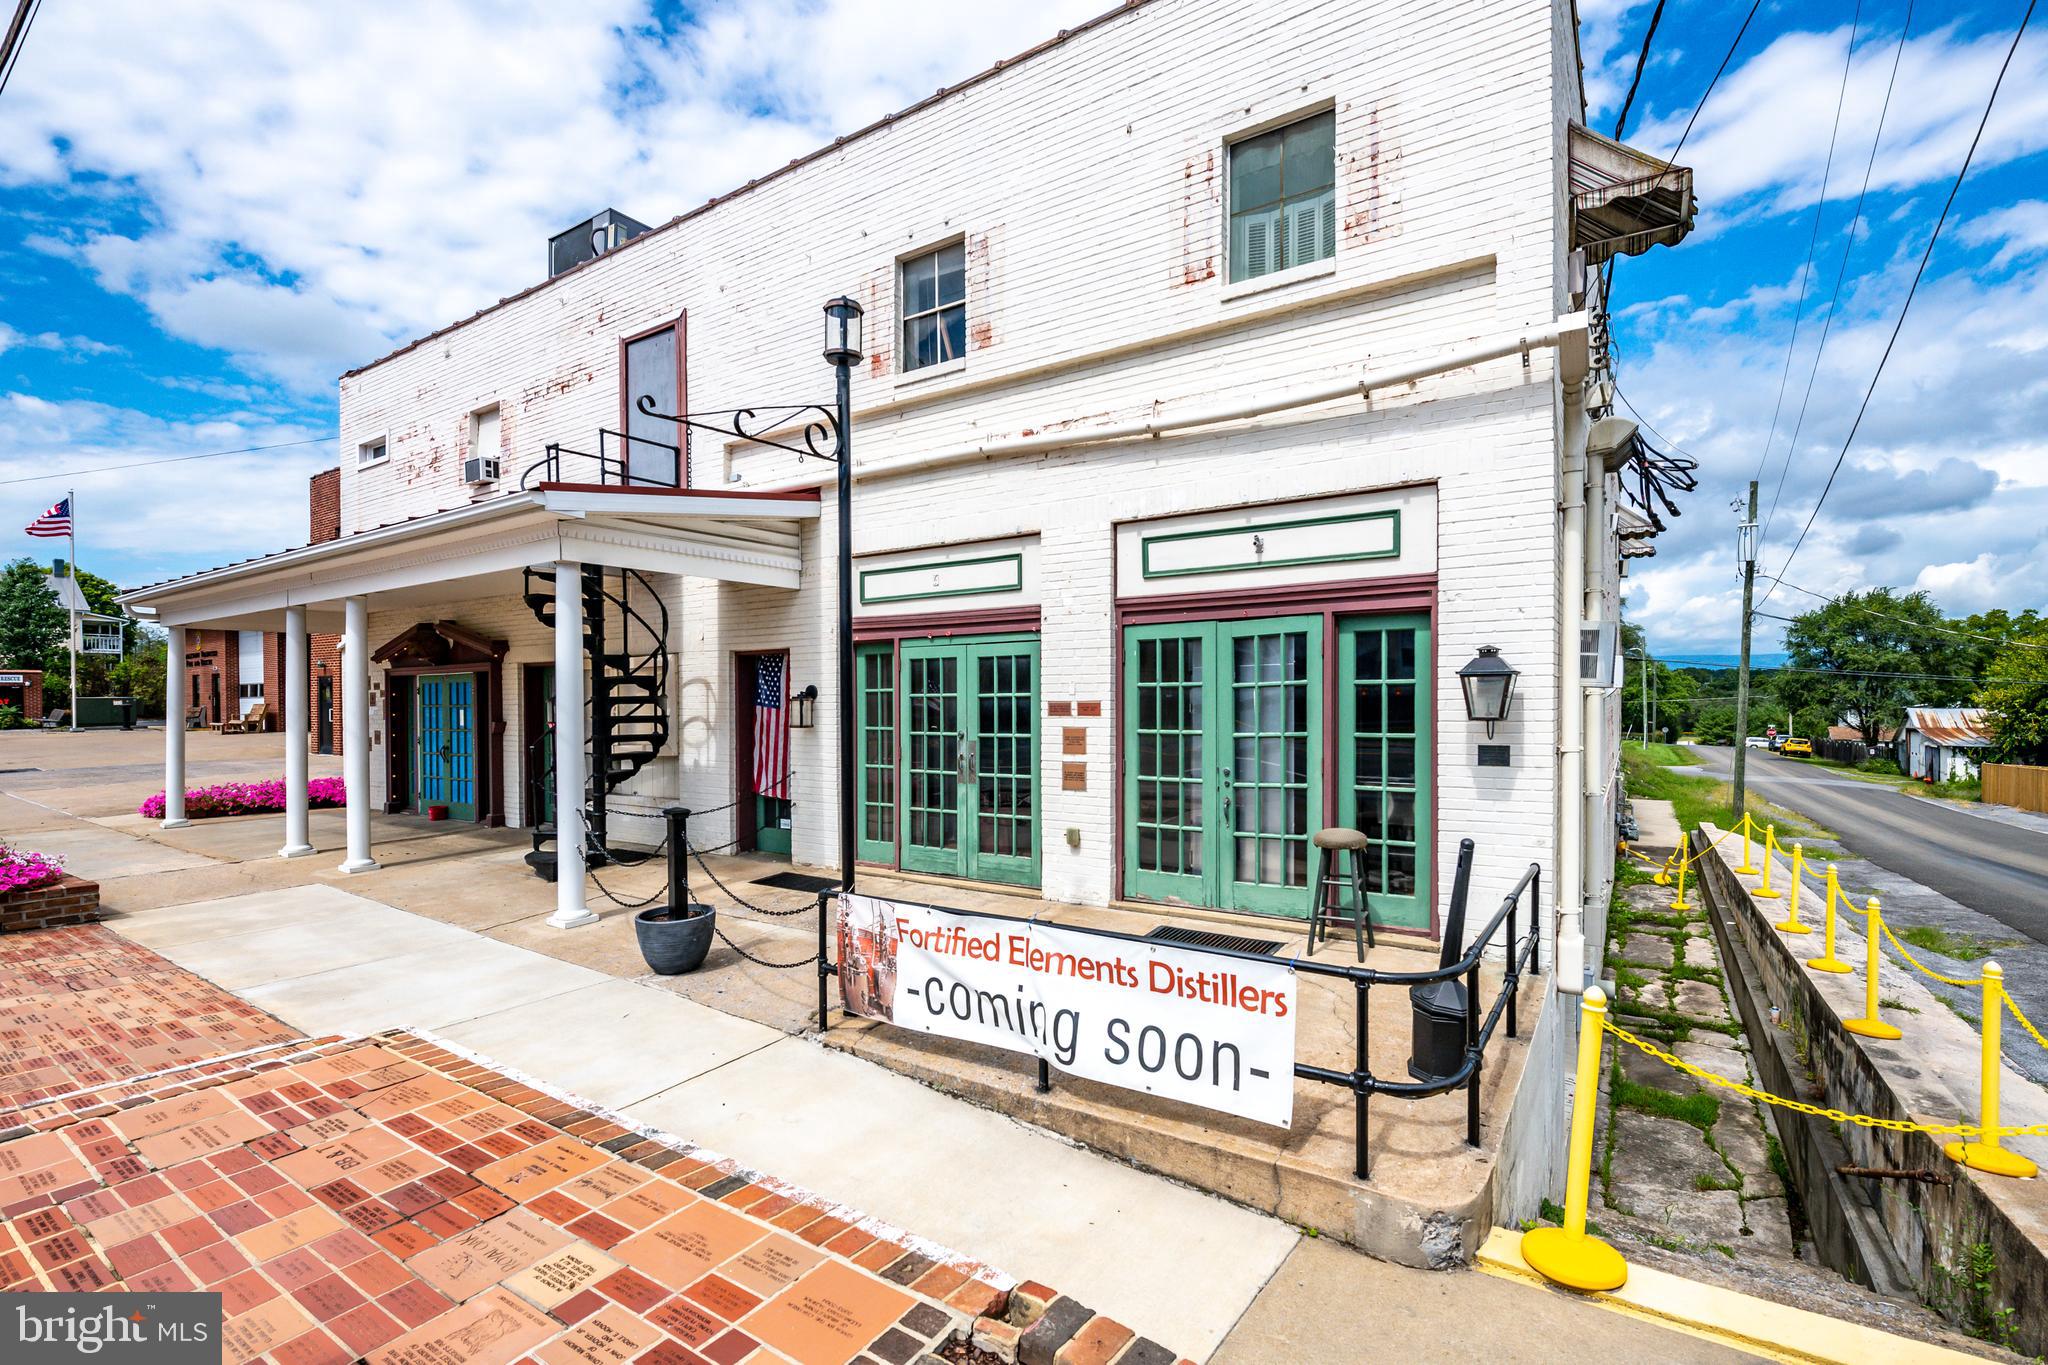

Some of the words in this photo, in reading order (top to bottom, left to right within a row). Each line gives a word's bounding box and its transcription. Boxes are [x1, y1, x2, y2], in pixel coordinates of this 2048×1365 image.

[896, 917, 1000, 962] Fortified
[1008, 935, 1139, 988] Elements
[1149, 960, 1288, 1017] Distillers
[333, 1156, 360, 1169] BB
[456, 1233, 490, 1253] OAK
[479, 1247, 521, 1272] ROYAL
[591, 1319, 613, 1333] HOOVER
[561, 1338, 585, 1354] MEMORY
[600, 1334, 614, 1343] AND
[616, 1334, 639, 1349] CAROLE
[608, 1349, 626, 1360] JOHN
